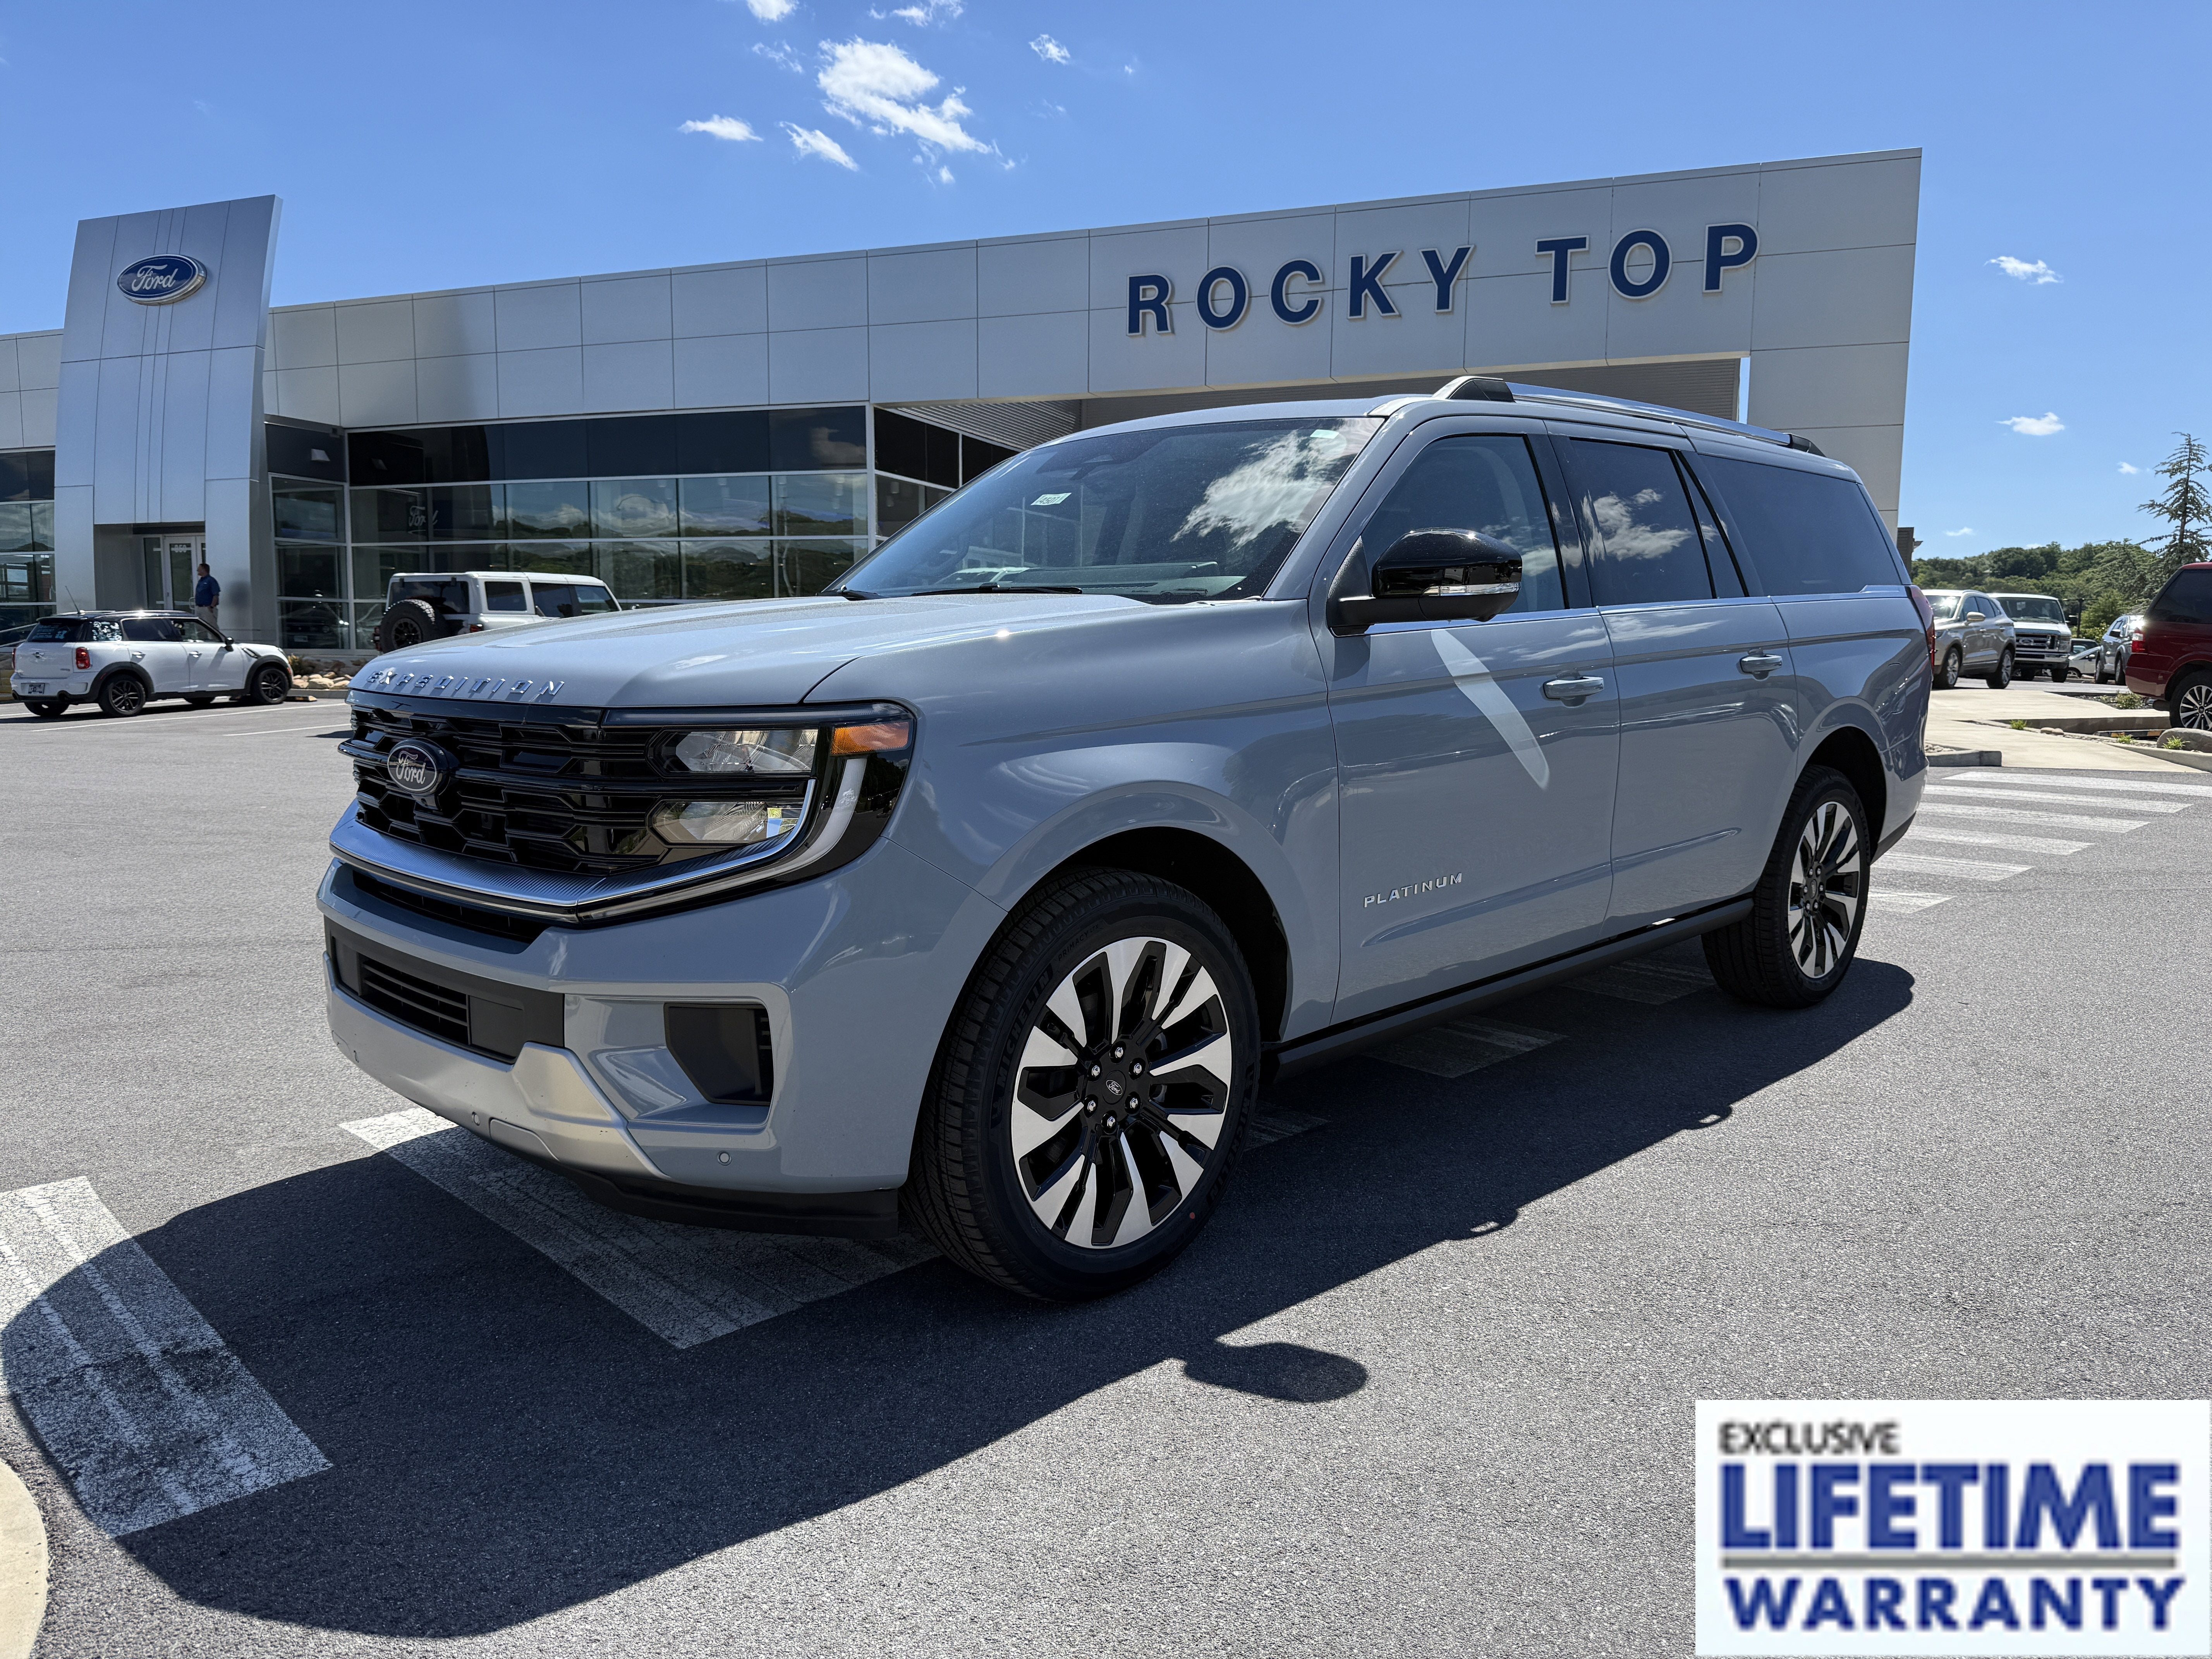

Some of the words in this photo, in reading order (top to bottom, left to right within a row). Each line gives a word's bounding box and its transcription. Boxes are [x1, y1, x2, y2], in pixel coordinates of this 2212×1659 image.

[132, 264, 178, 292] Ford
[1125, 245, 1475, 338] ROCKY
[1535, 222, 1760, 304] TOP
[367, 671, 565, 696] EXPEDITION
[396, 750, 426, 785] Ford
[1364, 872, 1462, 908] PLATINUM
[1058, 931, 1089, 962] PRIMACY
[1090, 924, 1099, 933] LTX
[996, 969, 1050, 1087] MICHELIN
[1108, 1082, 1121, 1094] Ford
